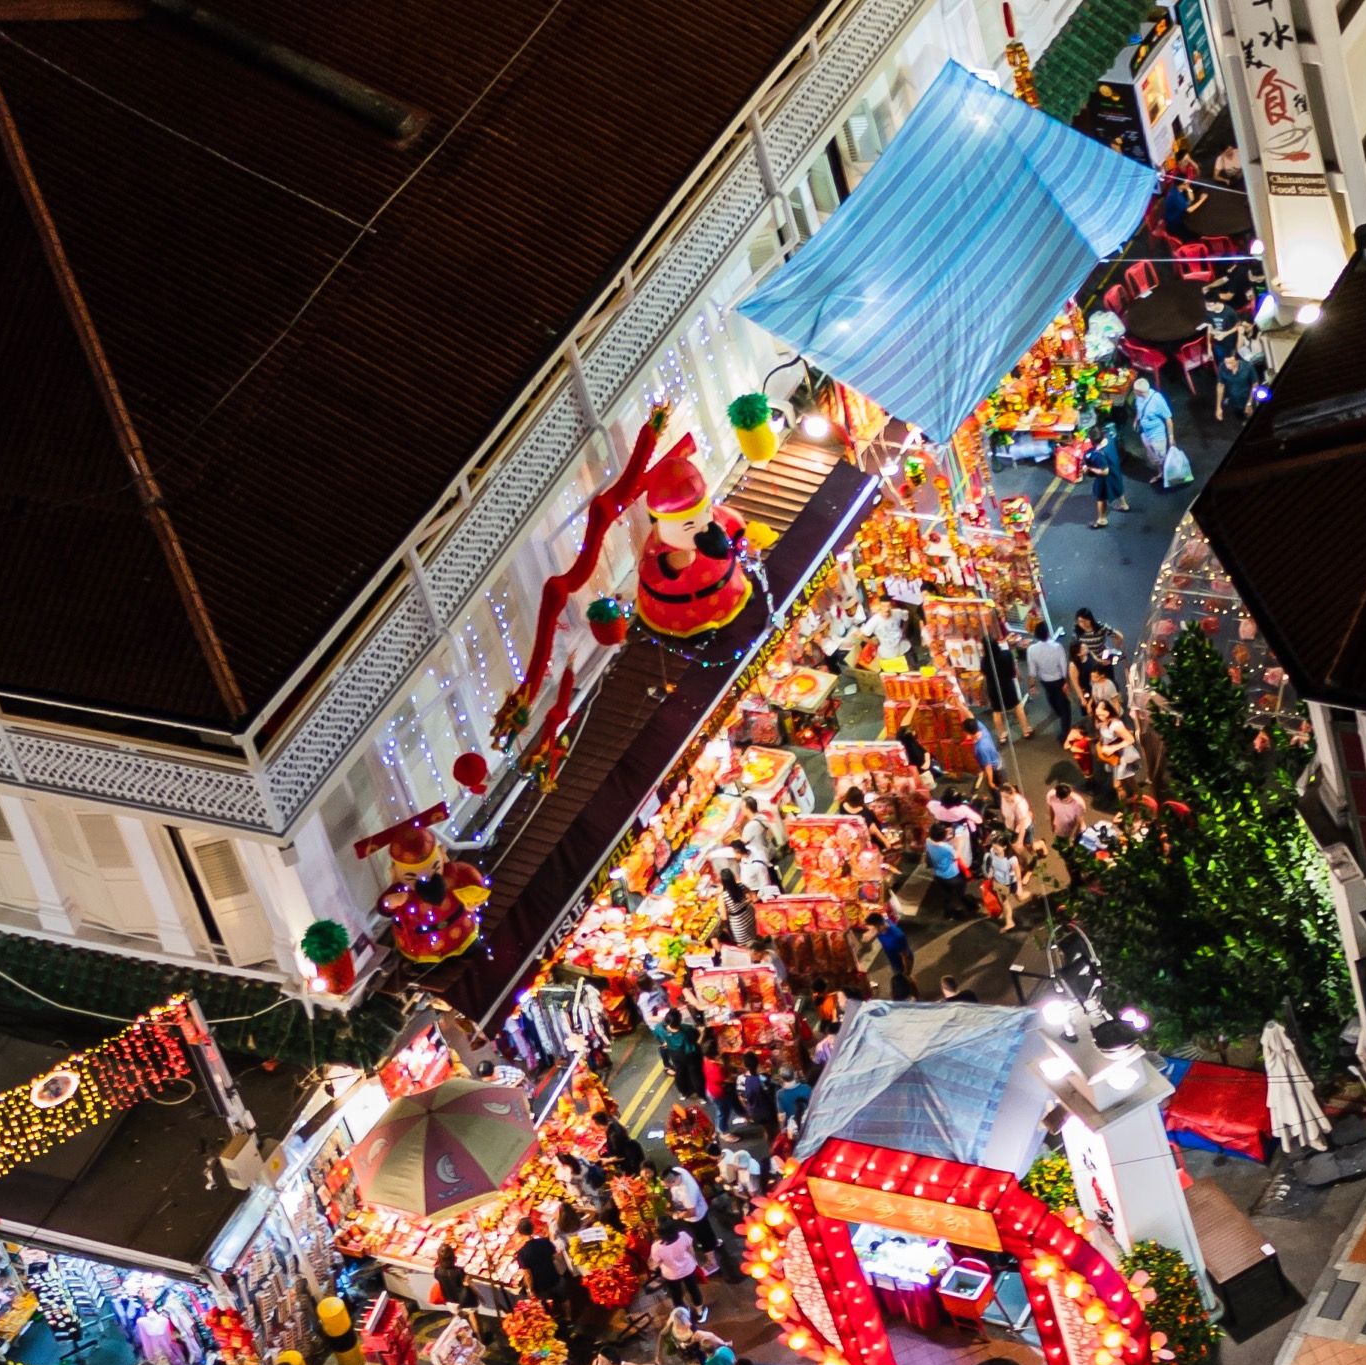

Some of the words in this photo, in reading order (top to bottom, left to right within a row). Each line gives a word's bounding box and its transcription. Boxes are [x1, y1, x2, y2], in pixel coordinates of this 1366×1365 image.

[1270, 186, 1295, 194] Food
[736, 617, 791, 690] Wholesae
[803, 551, 835, 600] Retail
